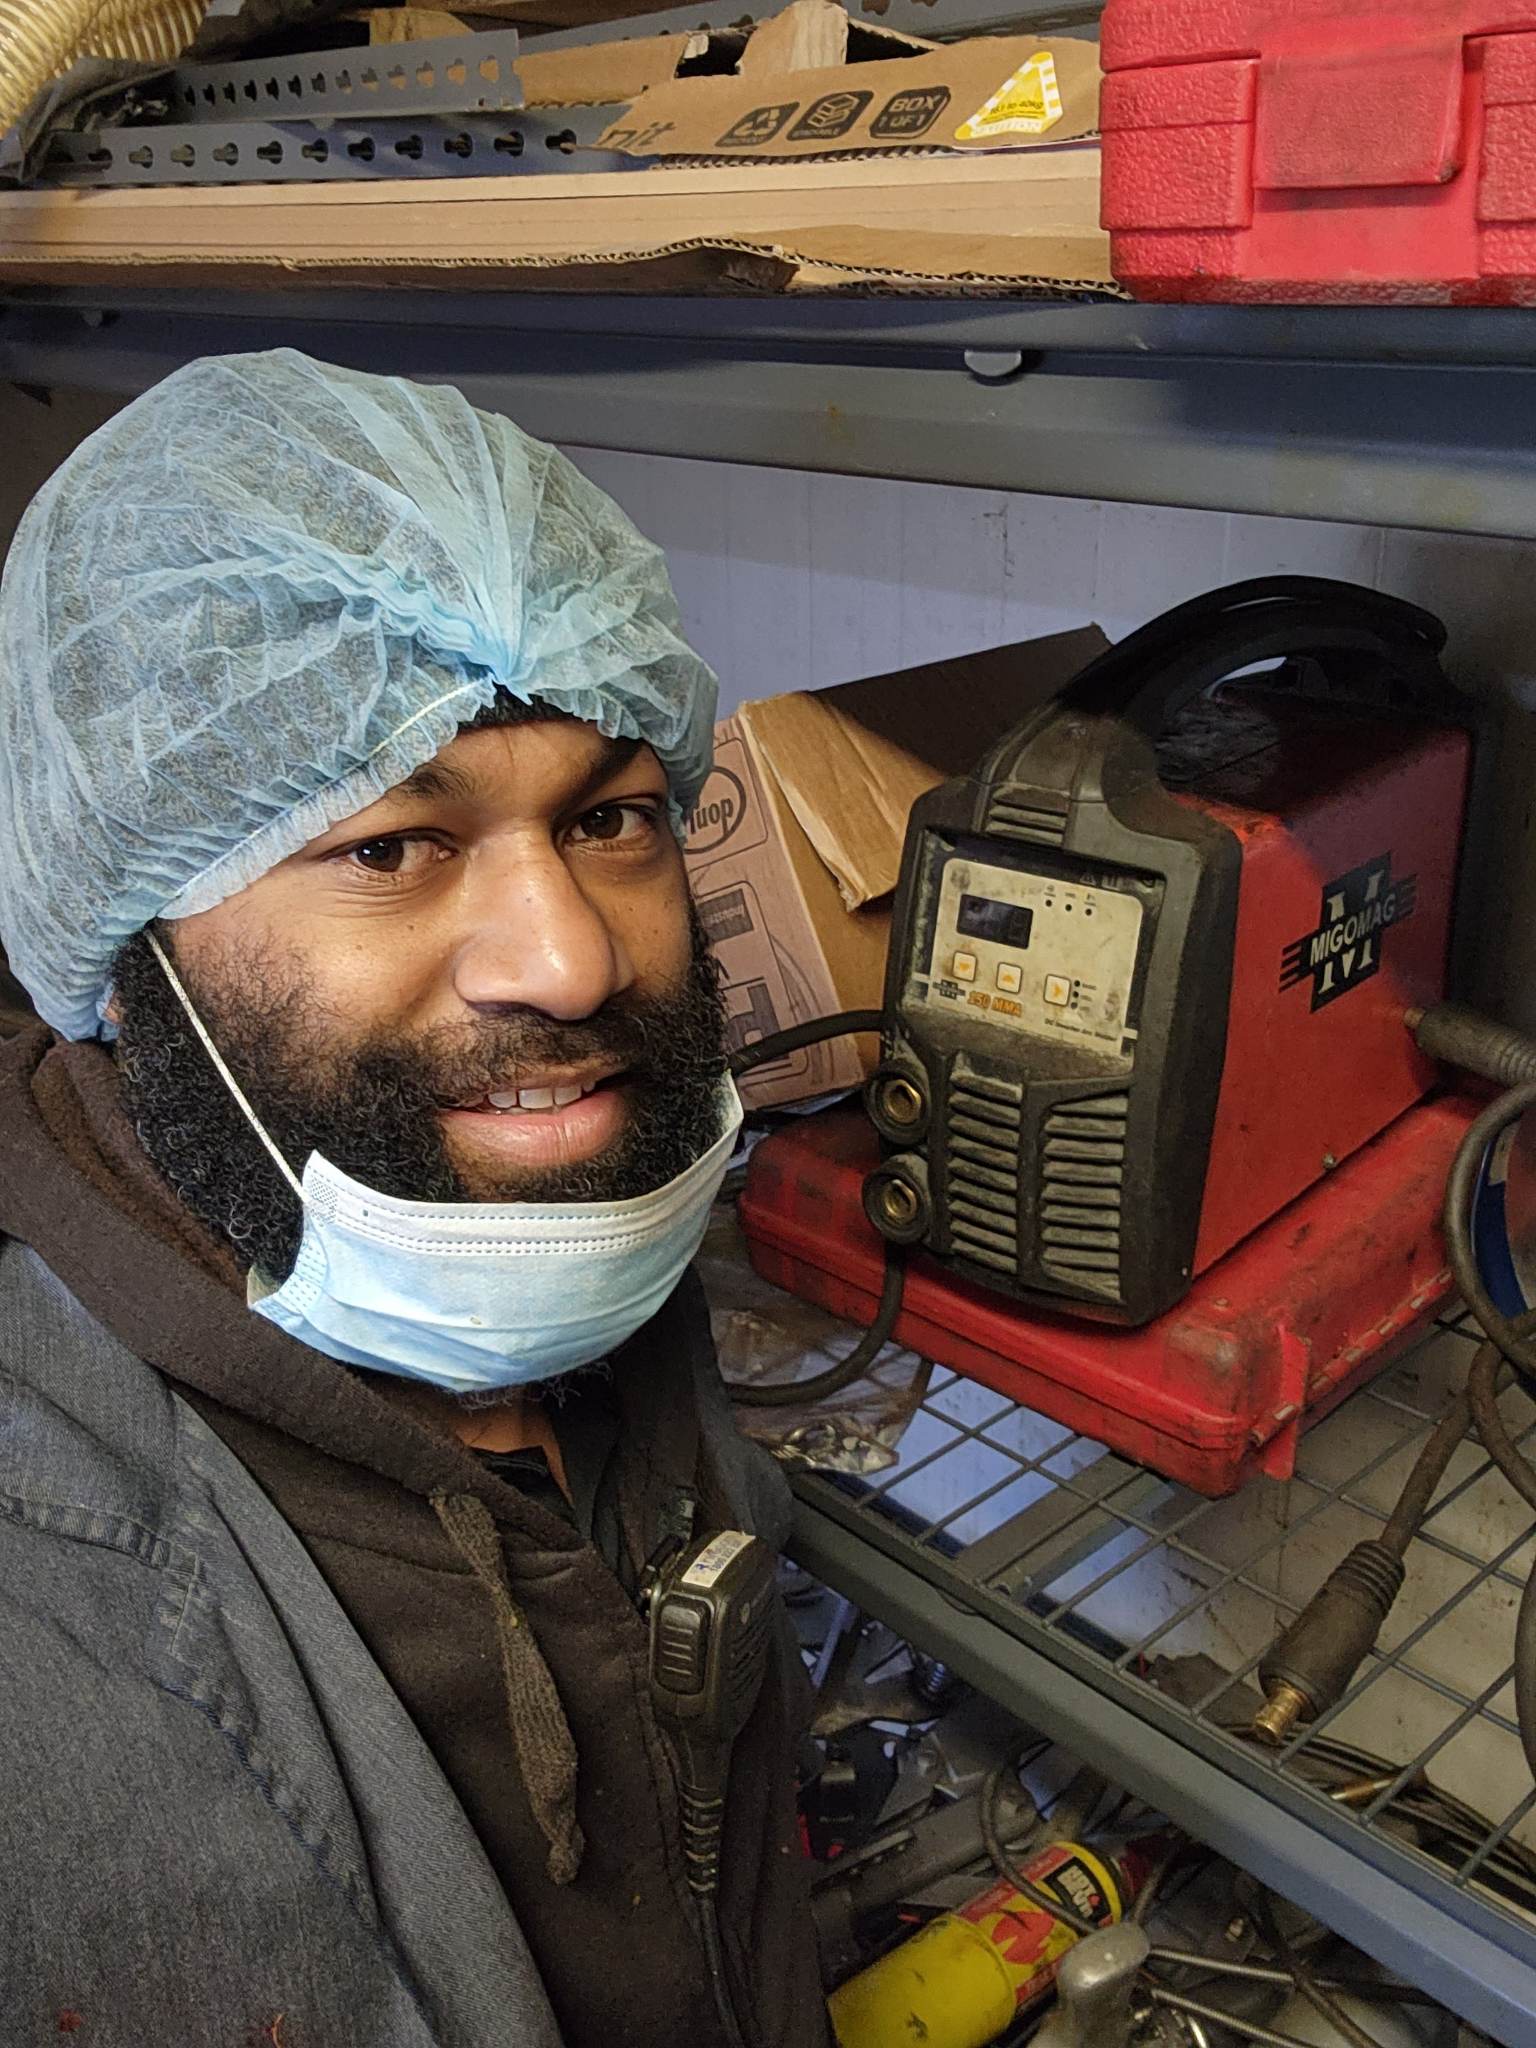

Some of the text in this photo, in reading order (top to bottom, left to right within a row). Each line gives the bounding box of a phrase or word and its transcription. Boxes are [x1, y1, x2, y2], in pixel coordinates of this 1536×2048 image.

[889, 95, 942, 113] BOX
[878, 114, 925, 128] 1 OF 1
[1310, 893, 1396, 966] MIGOMAG
